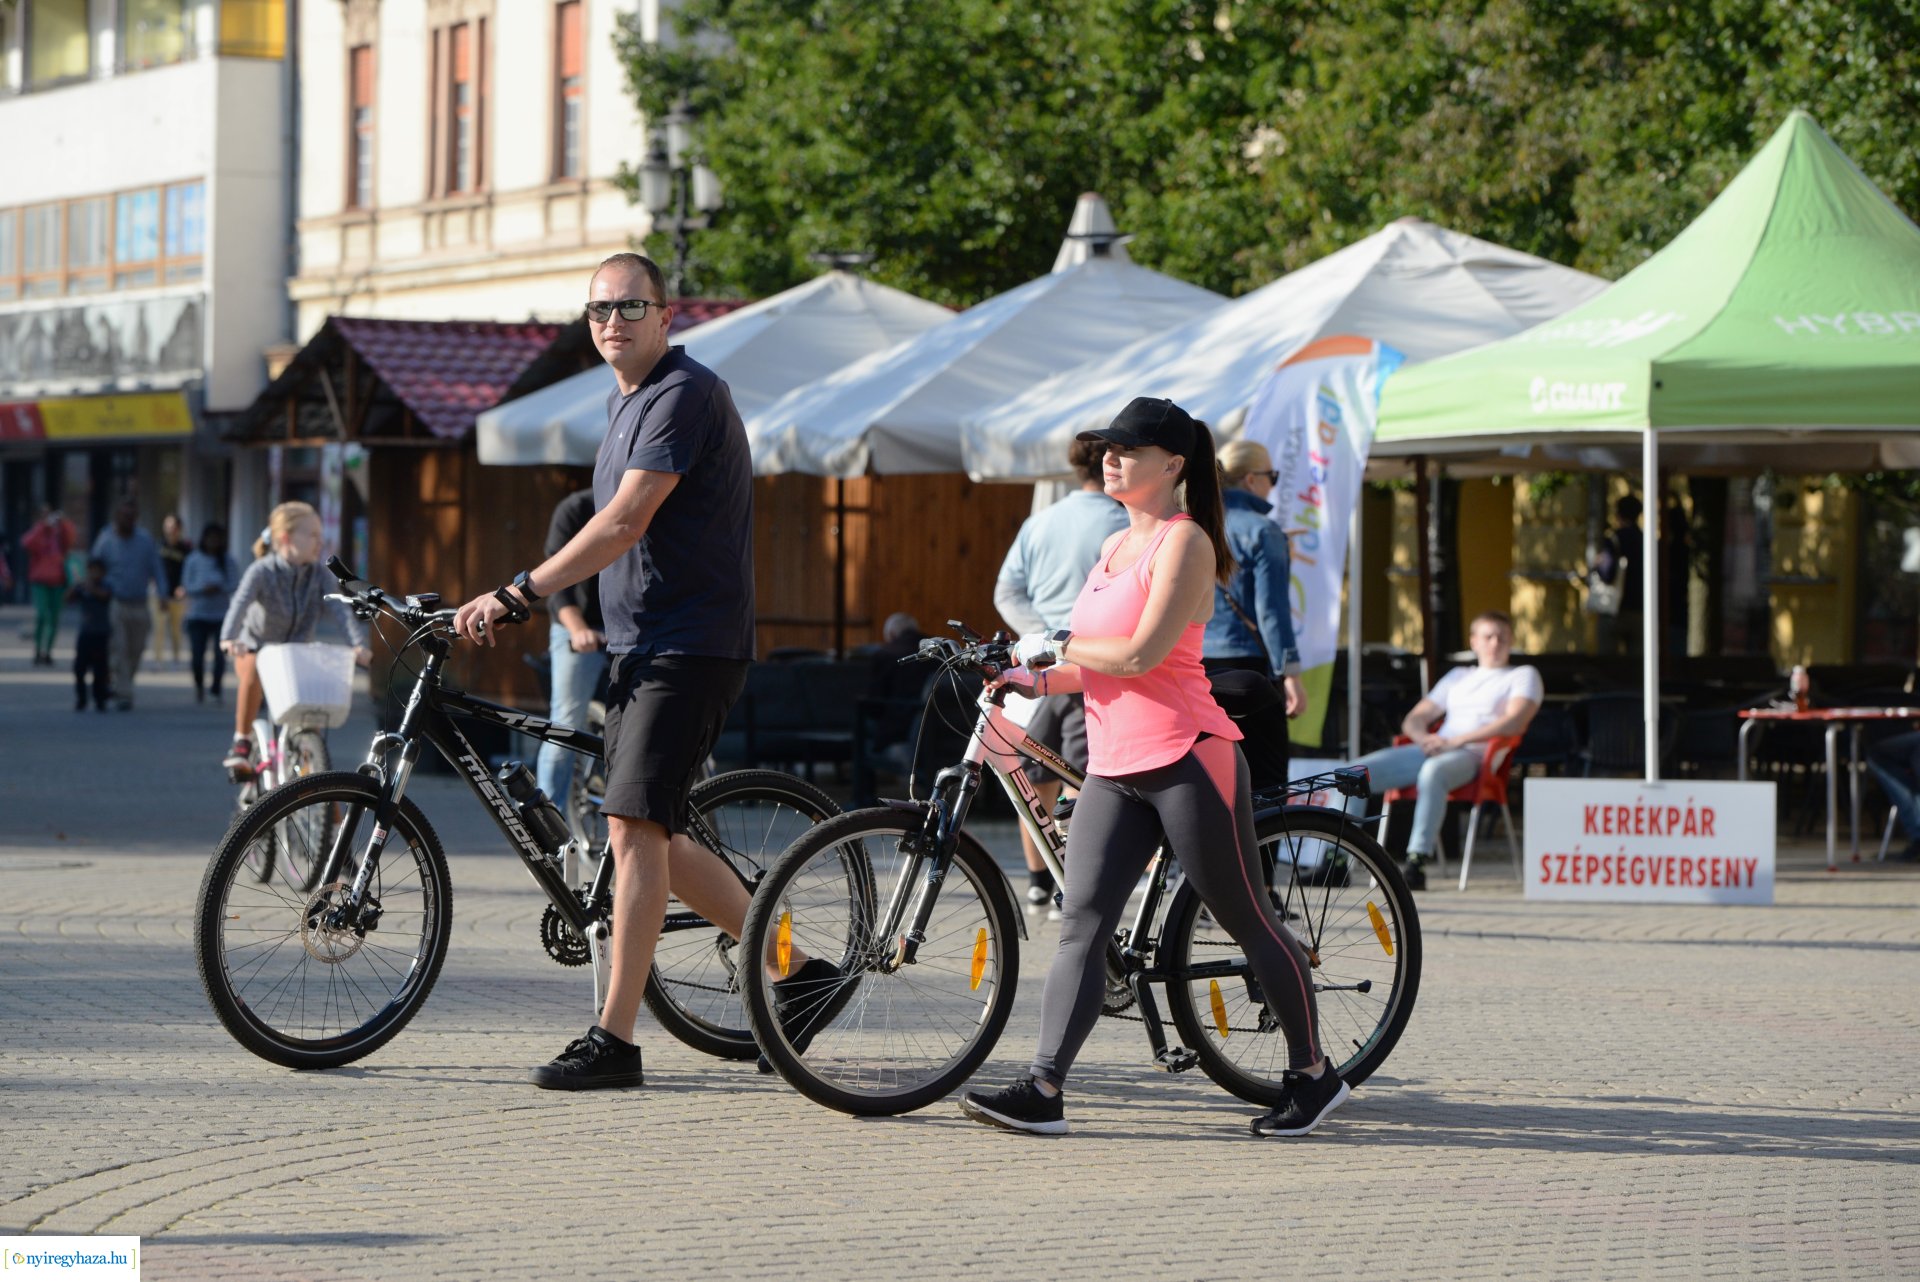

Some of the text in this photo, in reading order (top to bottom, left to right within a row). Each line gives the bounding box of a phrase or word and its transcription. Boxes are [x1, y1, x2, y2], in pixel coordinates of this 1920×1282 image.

[1550, 382, 1627, 410] GIANT
[1024, 737, 1067, 768] SHARPTAIL
[458, 754, 544, 862] MERIDA
[1584, 796, 1716, 837] KERÉKPÁR
[702, 832, 721, 855] SERIES
[1539, 845, 1759, 889] SZÉPSÉGVERSENY
